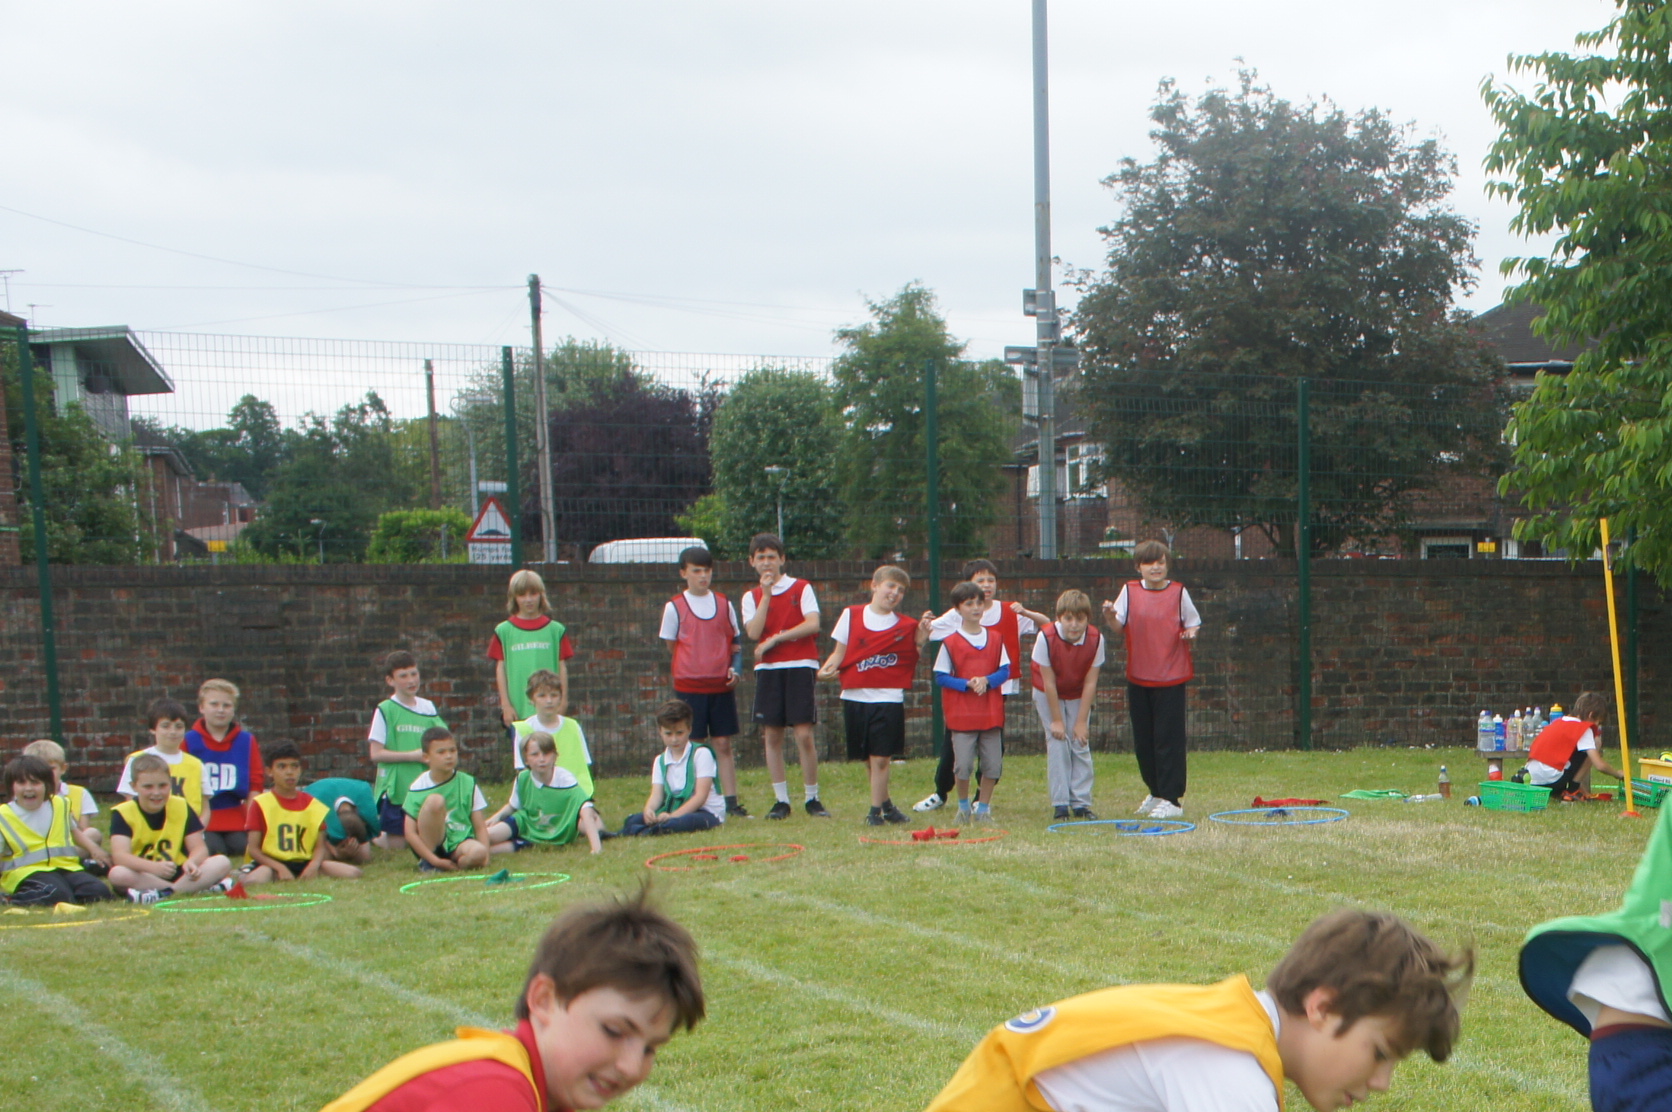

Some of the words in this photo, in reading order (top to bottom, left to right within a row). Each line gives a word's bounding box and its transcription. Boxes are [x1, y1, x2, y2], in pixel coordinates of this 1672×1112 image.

[511, 642, 551, 651] GILBERT
[203, 762, 237, 792] GD
[138, 839, 173, 862] GS
[278, 823, 307, 855] GK
